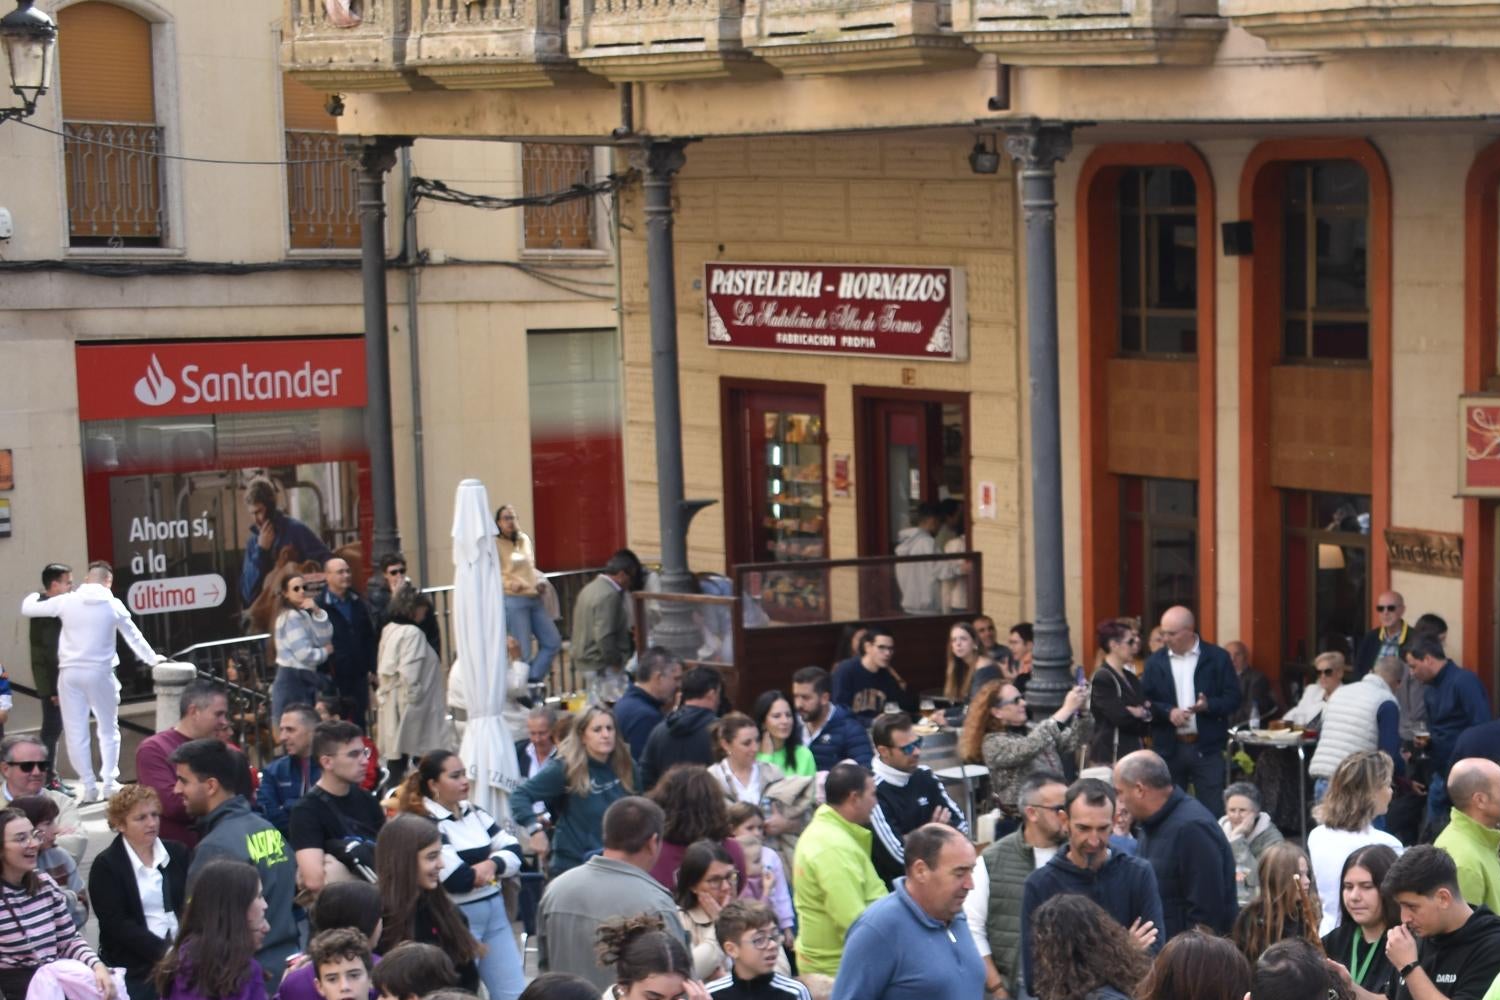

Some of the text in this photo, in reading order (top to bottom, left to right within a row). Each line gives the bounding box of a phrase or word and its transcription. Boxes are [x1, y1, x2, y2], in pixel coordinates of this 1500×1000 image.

[838, 272, 947, 301] HORNAZOS
[878, 304, 923, 334] Tormes
[841, 335, 876, 349] PROPIA
[182, 361, 342, 404] Santander
[129, 510, 214, 542] Ahora sí,
[148, 549, 167, 574] la
[134, 584, 196, 610] última
